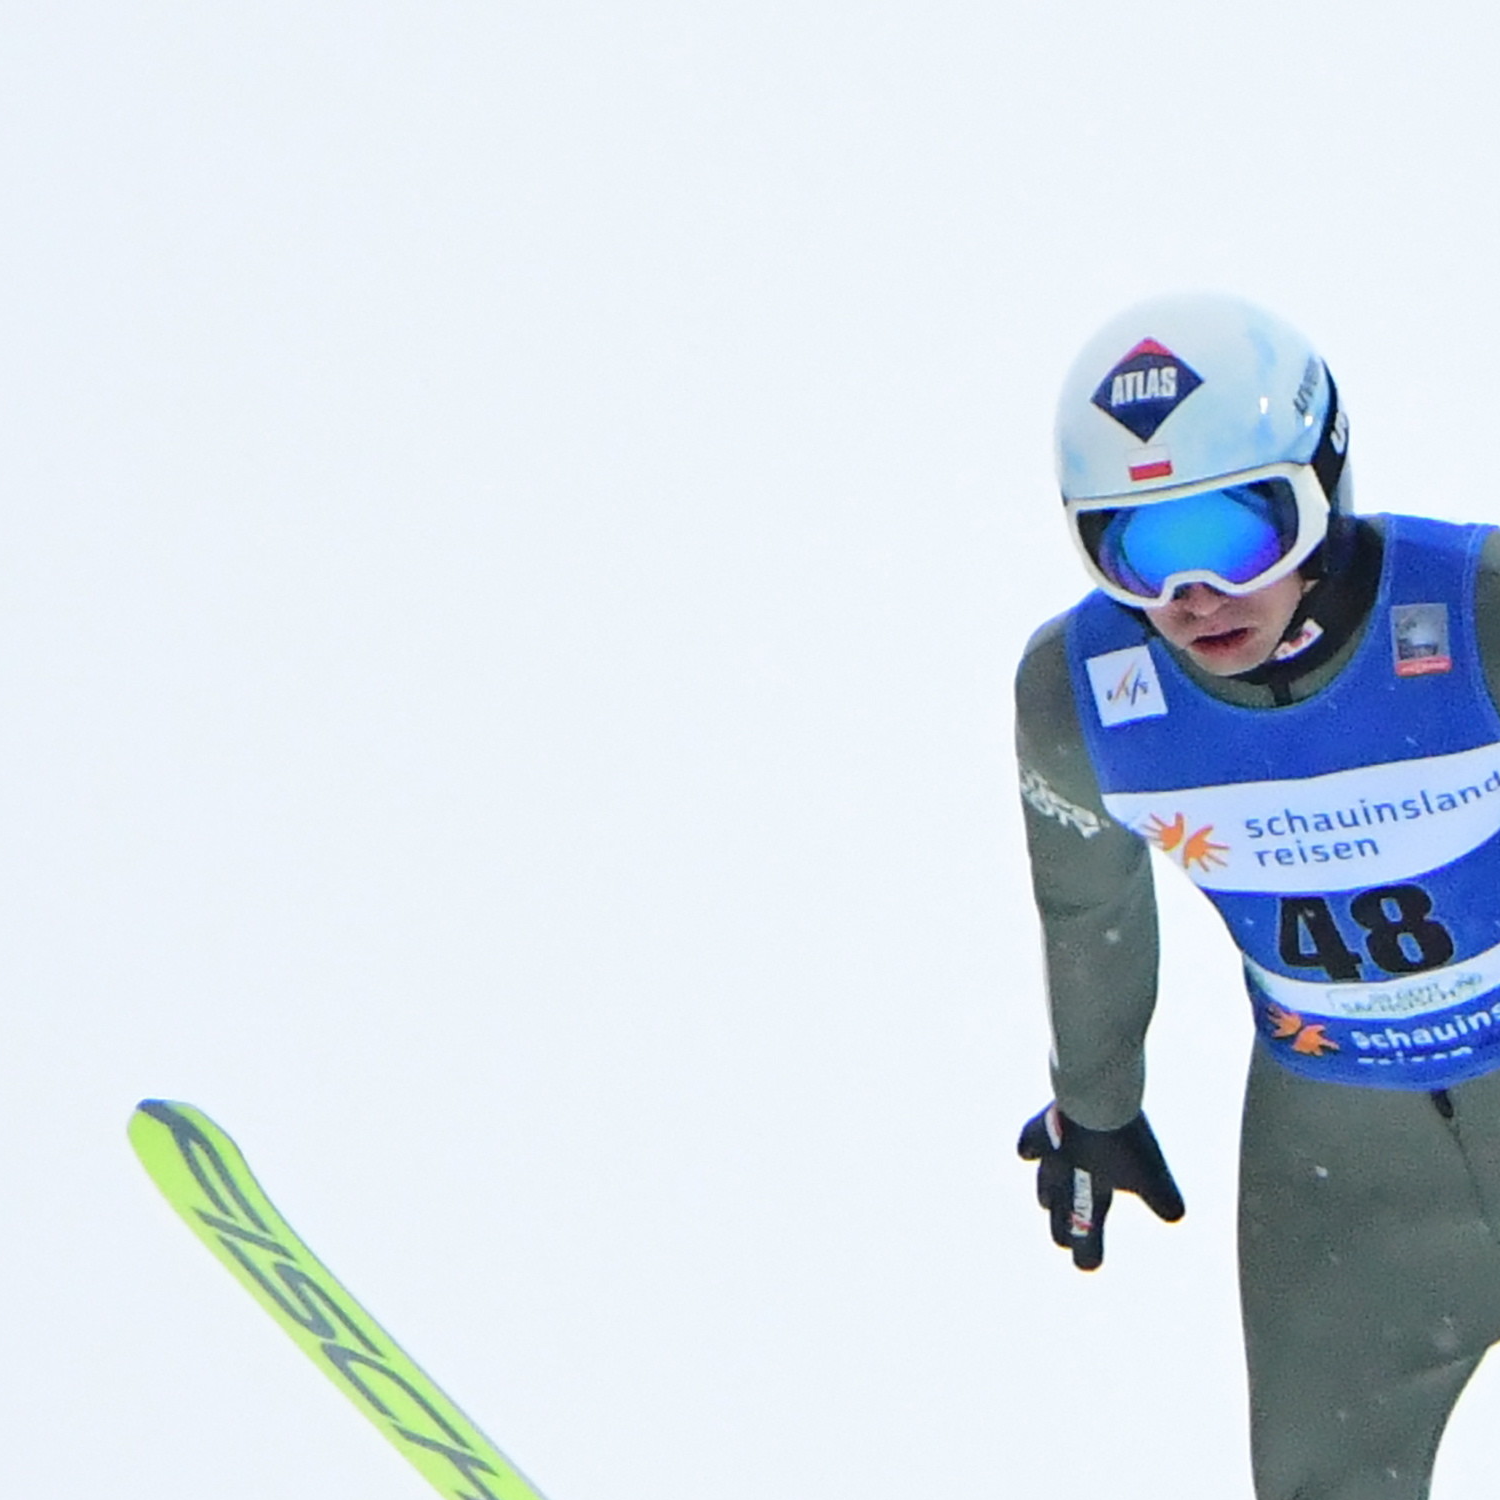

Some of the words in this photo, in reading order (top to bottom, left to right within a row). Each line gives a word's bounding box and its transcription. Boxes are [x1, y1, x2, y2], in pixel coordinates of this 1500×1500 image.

[1111, 366, 1178, 407] ATLAS
[1255, 836, 1380, 868] reisen
[1277, 883, 1456, 982] 48
